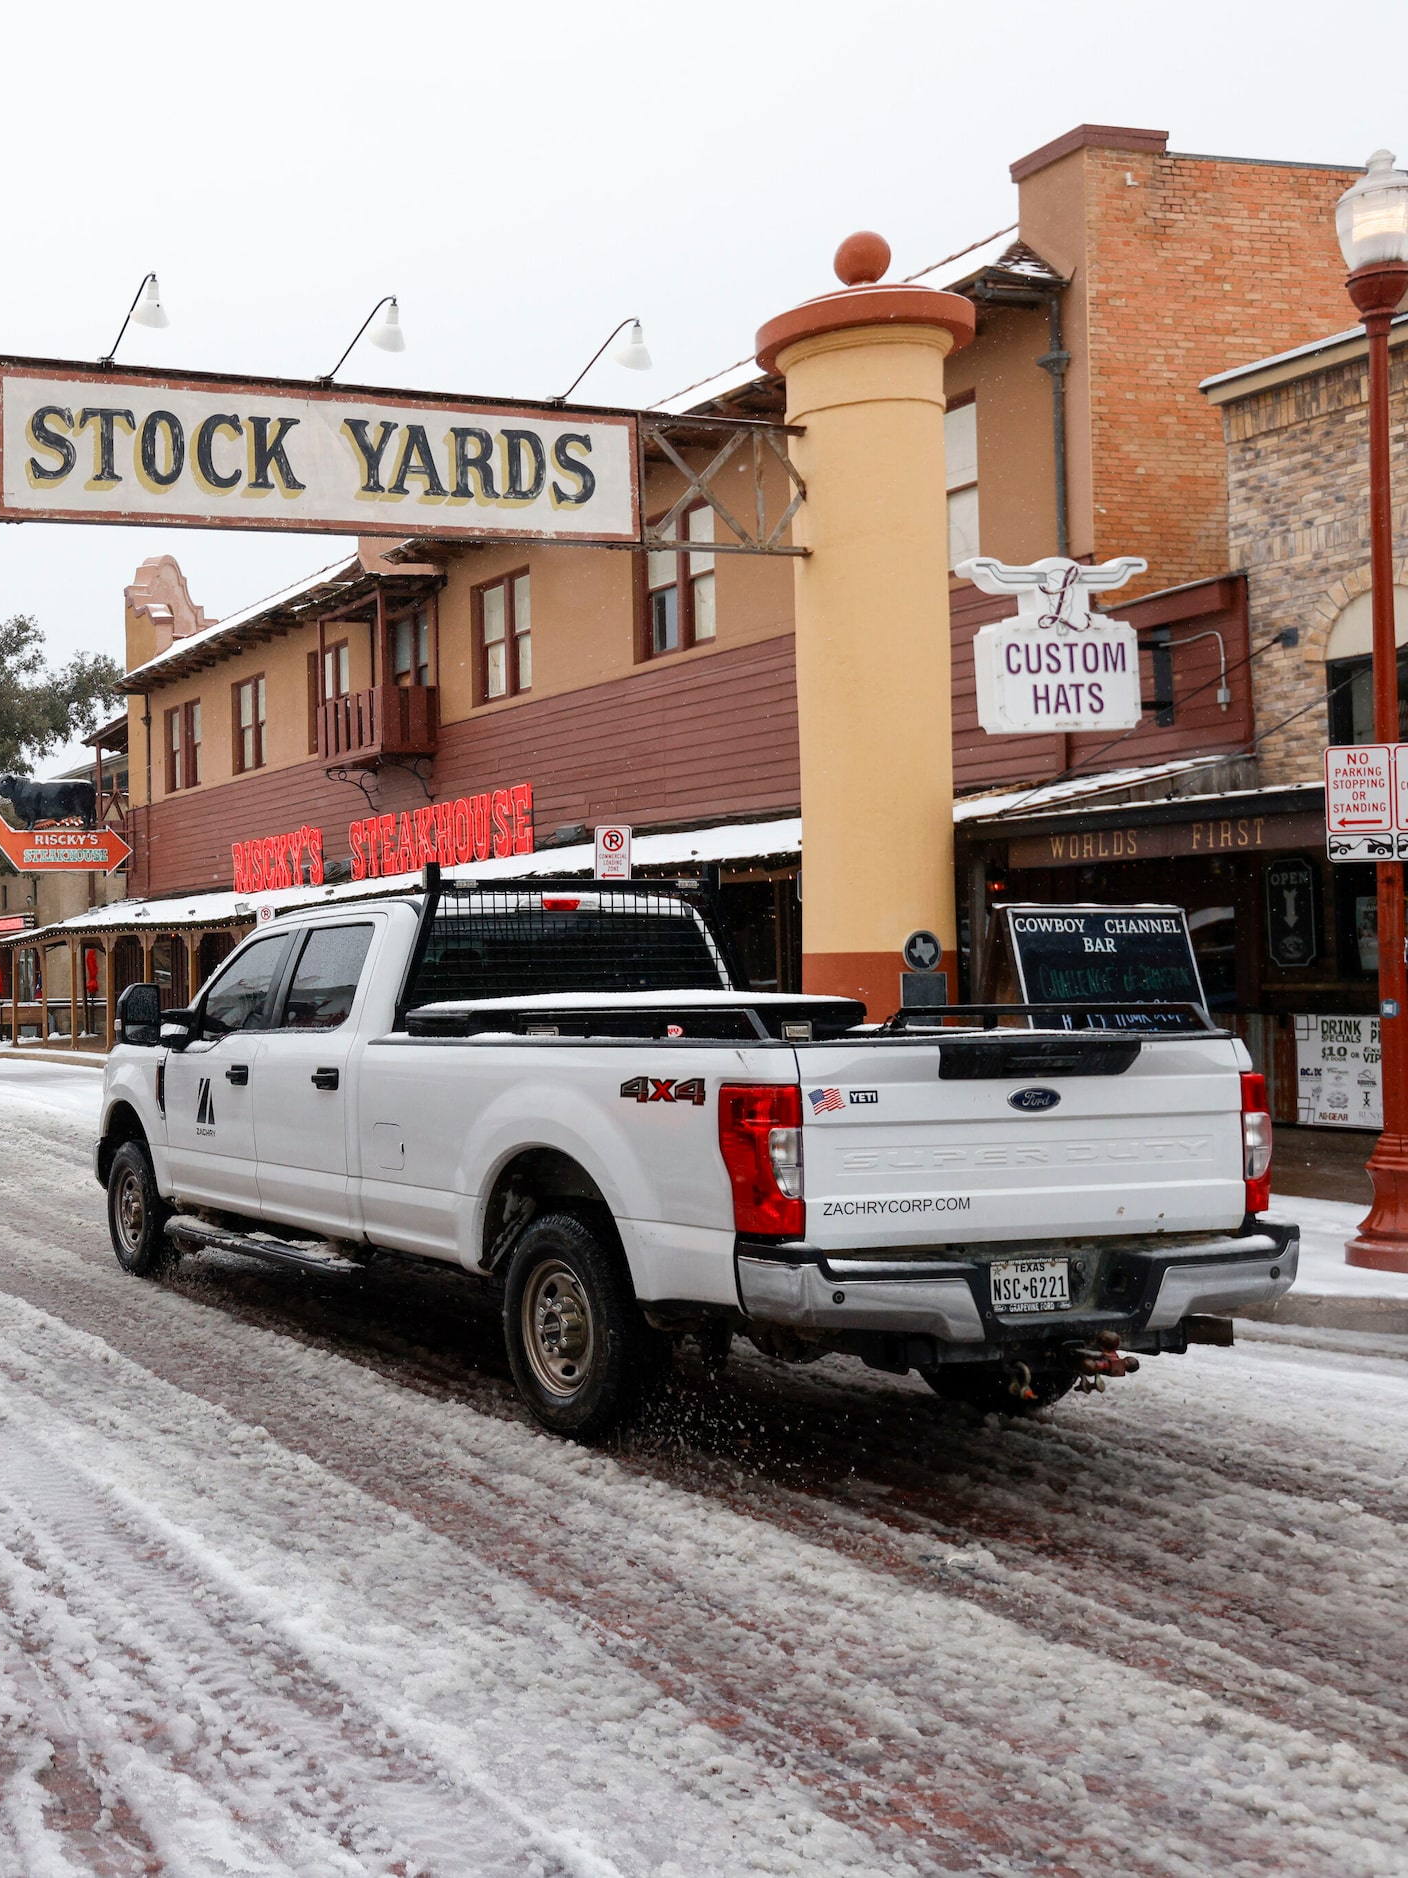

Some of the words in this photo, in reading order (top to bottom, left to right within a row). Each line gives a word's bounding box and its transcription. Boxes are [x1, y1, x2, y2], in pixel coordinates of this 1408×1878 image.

[27, 406, 306, 495] STOCK
[343, 418, 597, 508] YARDS
[1005, 642, 1126, 674] CUSTOM
[1032, 683, 1104, 714] HATS
[1347, 752, 1369, 765] NO
[1335, 766, 1382, 778] PARKING
[1333, 778, 1385, 790] STOPPING
[1352, 791, 1366, 801] OR
[1333, 802, 1386, 814] STANDING
[34, 833, 99, 846] RISCKY'S
[231, 825, 324, 893] RISCKY'S
[348, 783, 534, 880] STEAKHOUSE
[1050, 830, 1138, 860] WORLDS
[1191, 818, 1265, 849] FIRST
[23, 849, 109, 863] STEAKHOUSE
[1271, 871, 1309, 886] OPEN
[1014, 917, 1086, 933] COWBOY
[1104, 919, 1181, 934] CHANNEL
[1083, 937, 1118, 953] BAR
[1321, 1020, 1362, 1036] DRINK
[1321, 1035, 1361, 1043] SPECIALS
[1321, 1047, 1347, 1058] $10
[851, 1092, 877, 1103] YETI
[1022, 1091, 1051, 1108] Ford
[843, 1147, 1049, 1171] SUPER
[1066, 1140, 1209, 1162] DUTY
[823, 1197, 971, 1216] ZACHRYCORP.COM
[1014, 1263, 1045, 1273] TEXAS
[1009, 1303, 1040, 1312] GRAPEVINE
[1040, 1302, 1055, 1311] FORD
